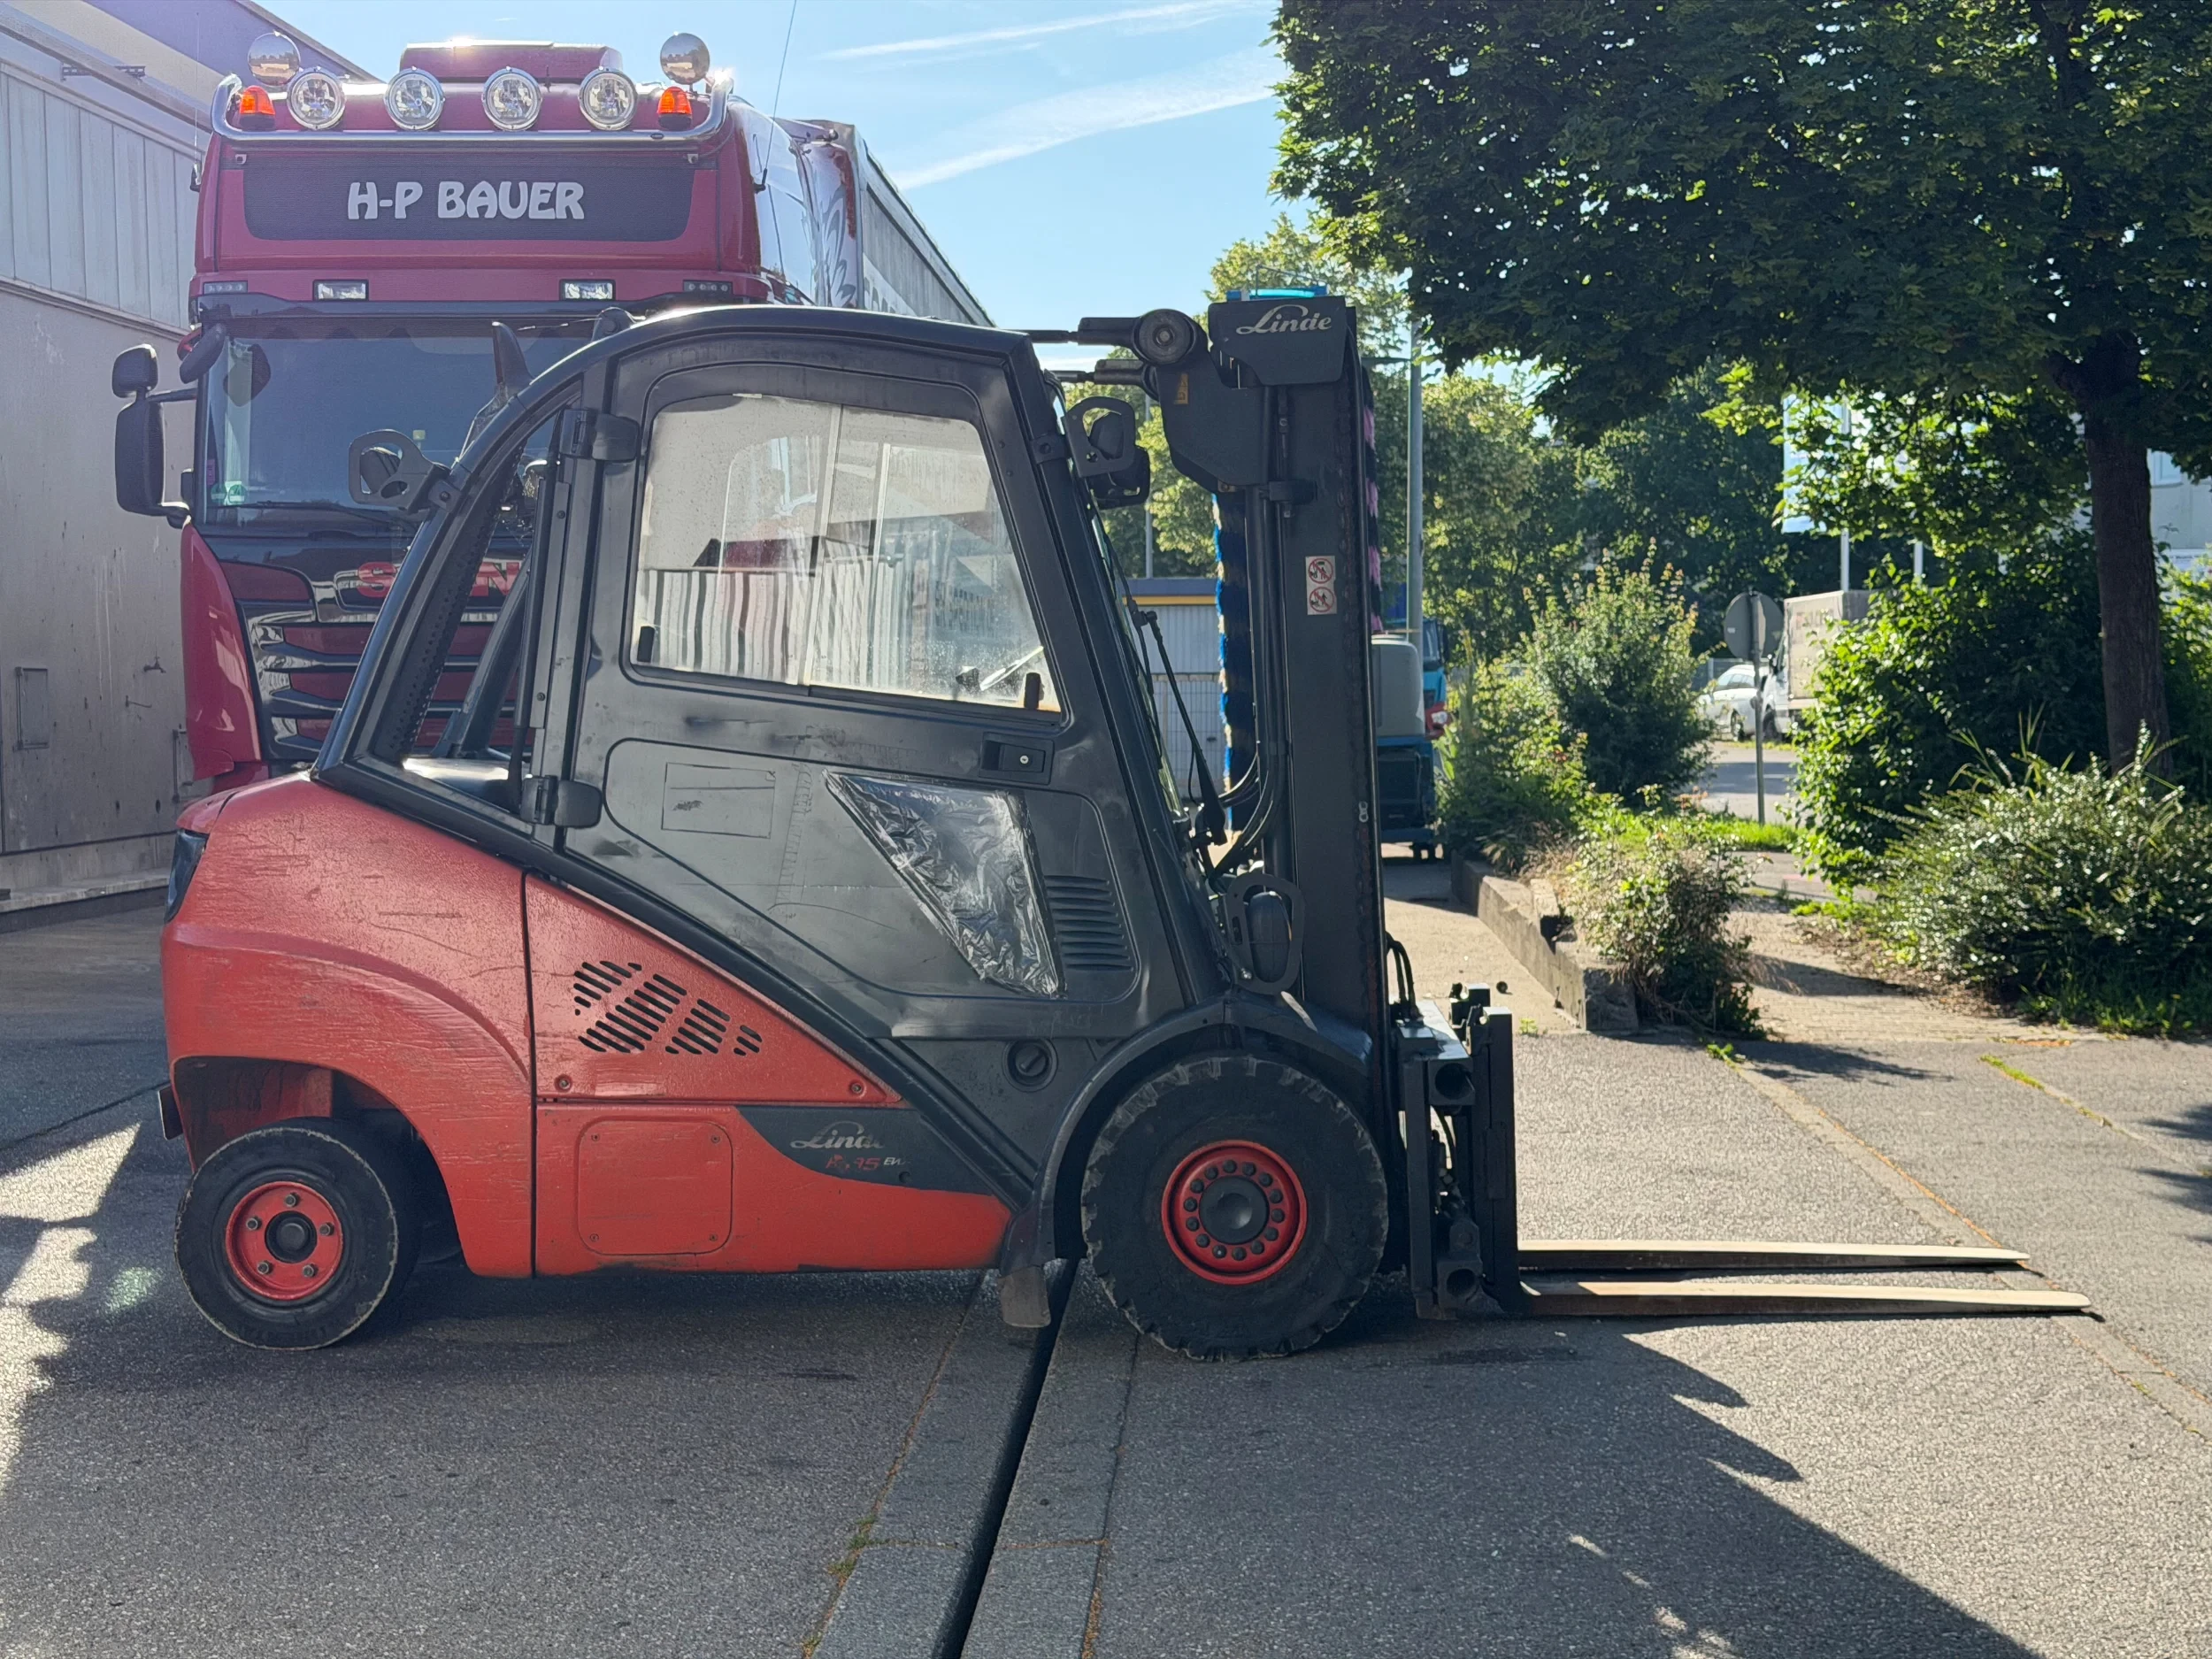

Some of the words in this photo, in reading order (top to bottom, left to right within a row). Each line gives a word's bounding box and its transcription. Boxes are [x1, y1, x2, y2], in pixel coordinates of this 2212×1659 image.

[348, 181, 423, 219] H-P
[437, 180, 584, 219] BAUER
[1236, 304, 1332, 334] Linde
